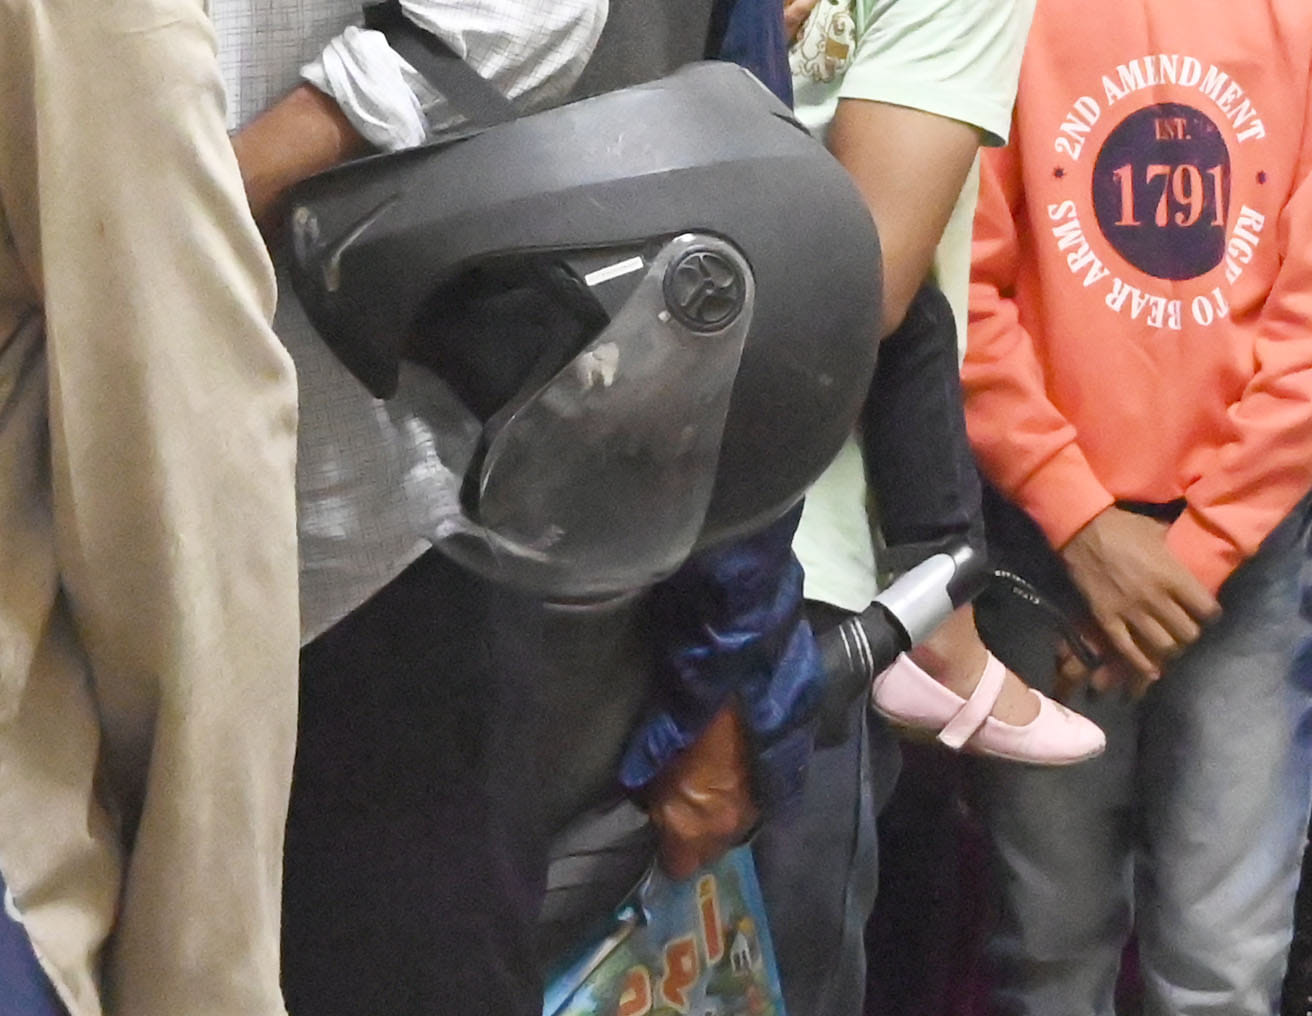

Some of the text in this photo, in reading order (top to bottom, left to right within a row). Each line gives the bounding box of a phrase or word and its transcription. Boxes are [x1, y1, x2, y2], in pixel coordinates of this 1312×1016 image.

[1054, 54, 1266, 161] 2ND AMENDMENT
[1112, 162, 1226, 228] 1791
[1047, 199, 1111, 287] ARMS
[1104, 277, 1182, 330] BEAR
